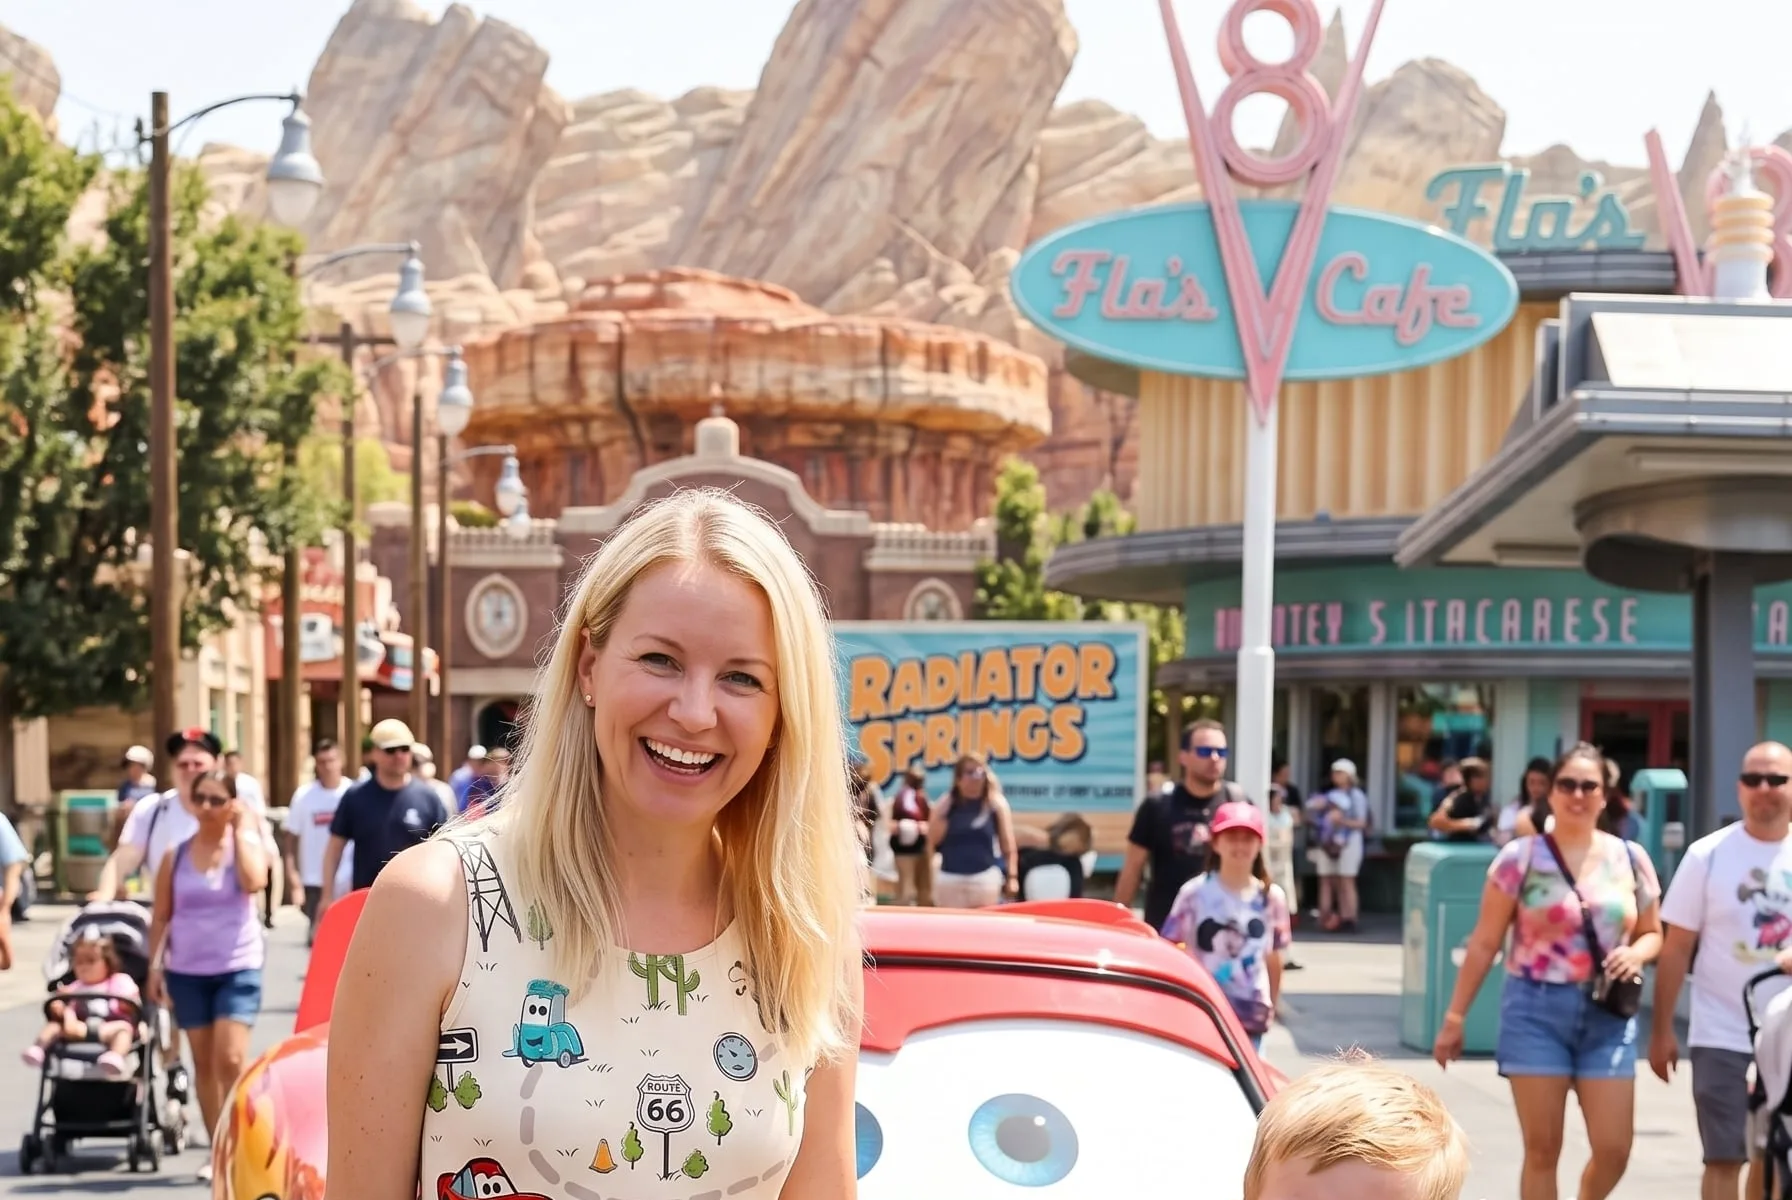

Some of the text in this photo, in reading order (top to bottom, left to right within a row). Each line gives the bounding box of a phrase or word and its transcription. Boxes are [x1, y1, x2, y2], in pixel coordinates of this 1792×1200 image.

[1316, 250, 1482, 345] Cafe
[850, 642, 1116, 721] RADIATOR
[860, 703, 1086, 786] SPRINGS
[647, 1082, 681, 1093] ROUTE
[647, 1098, 685, 1123] 66
